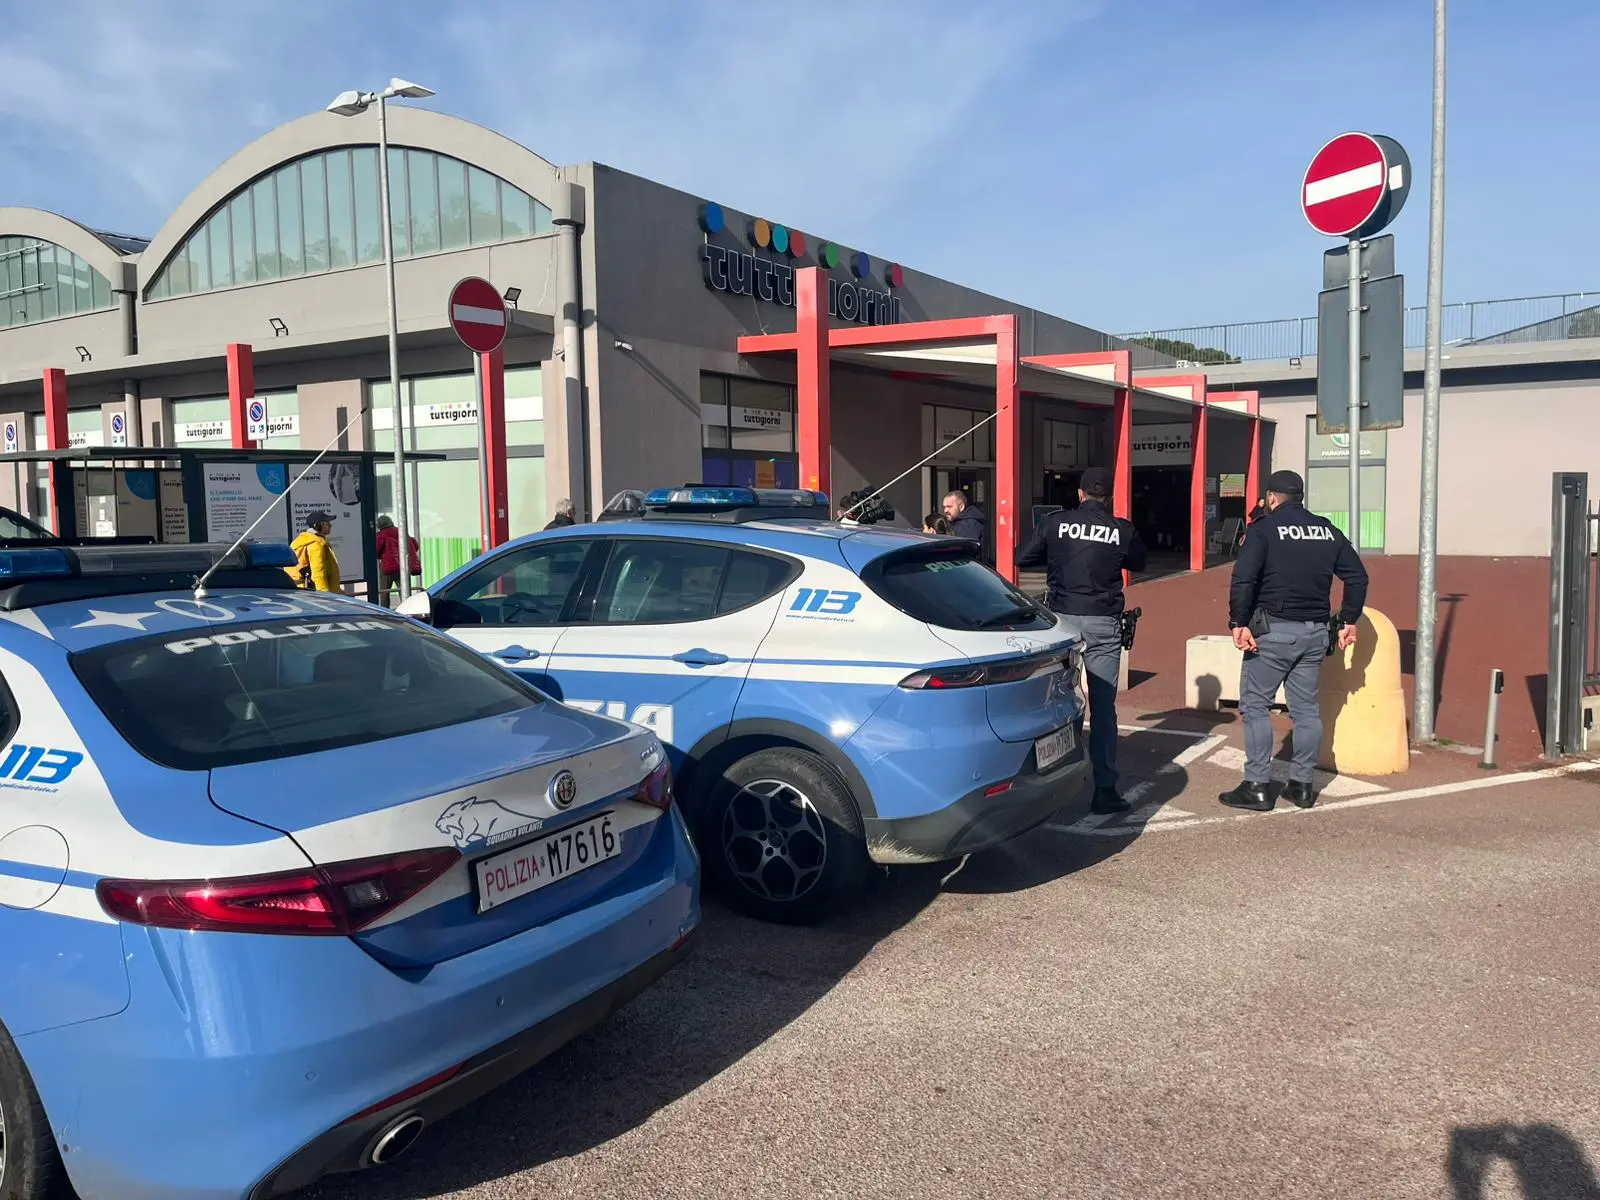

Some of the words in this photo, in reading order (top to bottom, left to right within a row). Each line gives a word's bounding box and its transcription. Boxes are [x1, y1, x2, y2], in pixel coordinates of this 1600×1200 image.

[430, 409, 478, 421] tuttigiorn
[744, 414, 781, 426] tuttigiorni
[186, 427, 223, 438] tuttigiorni
[1058, 522, 1120, 545] POLIZIA
[1278, 525, 1335, 541] POLIZIA
[789, 588, 862, 614] 113
[163, 620, 393, 655] POLIZIA
[0, 744, 84, 784] 113
[486, 830, 517, 846] SQUADRA
[517, 821, 544, 837] VOLANTE
[485, 856, 540, 897] POLIZIA
[547, 821, 615, 877] M7616
